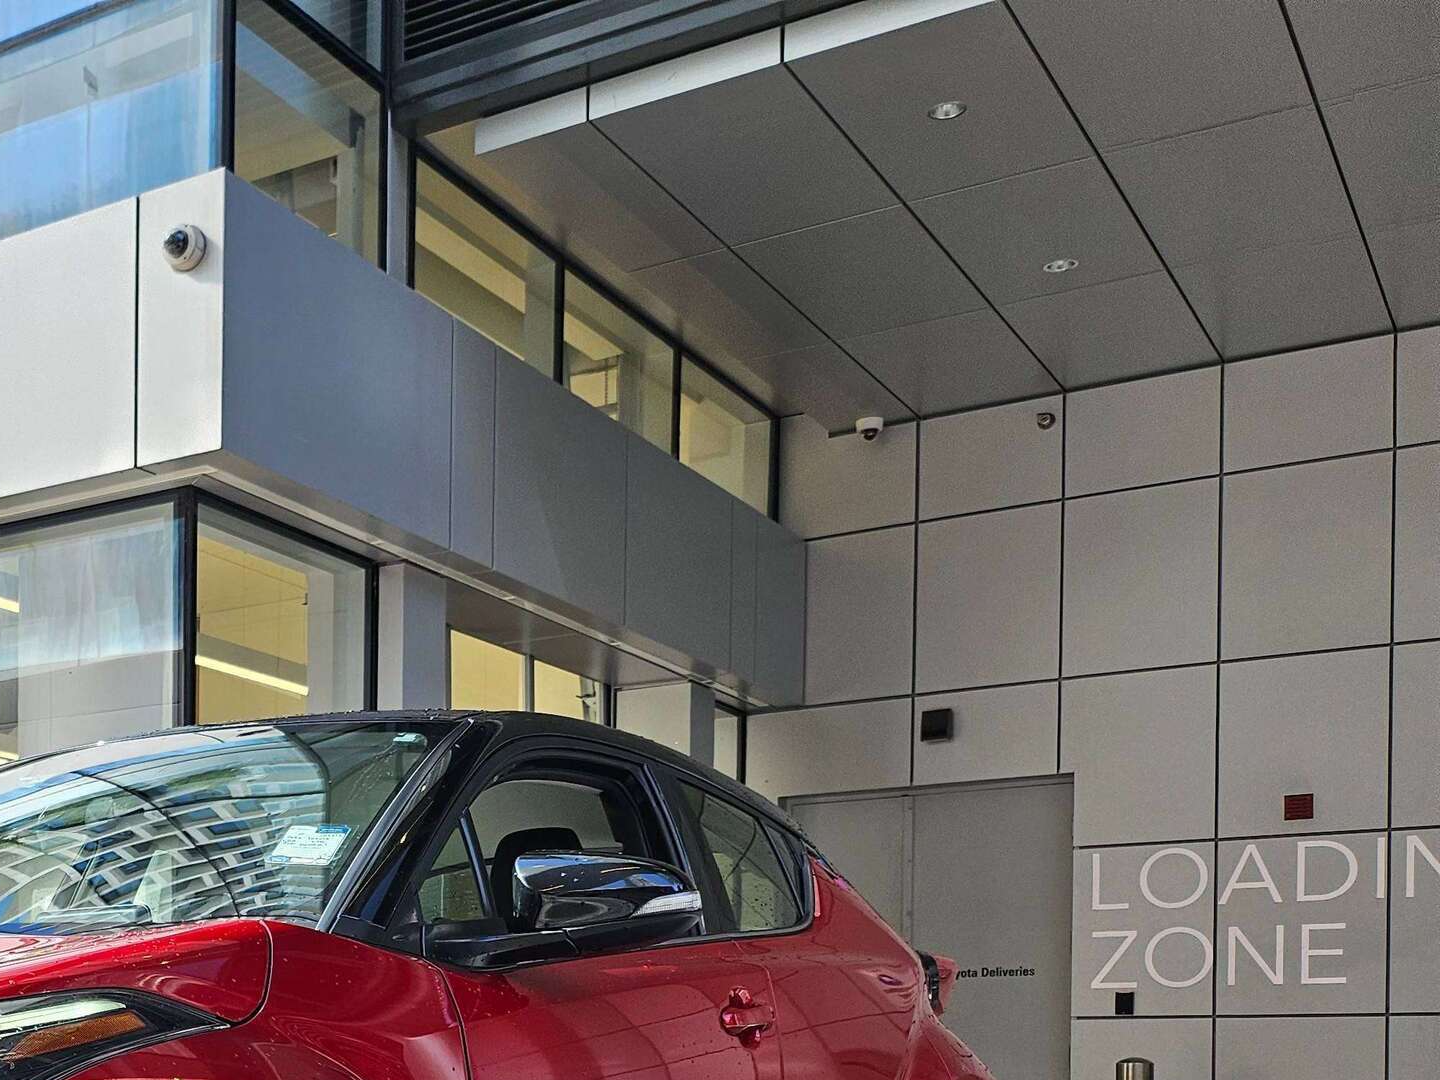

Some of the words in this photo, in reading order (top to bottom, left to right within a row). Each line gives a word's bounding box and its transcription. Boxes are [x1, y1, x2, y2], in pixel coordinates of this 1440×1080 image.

[1091, 833, 1440, 912] LOADIN
[956, 968, 978, 980] yota
[981, 966, 1035, 978] Deliveries
[1090, 921, 1347, 990] ZONE
